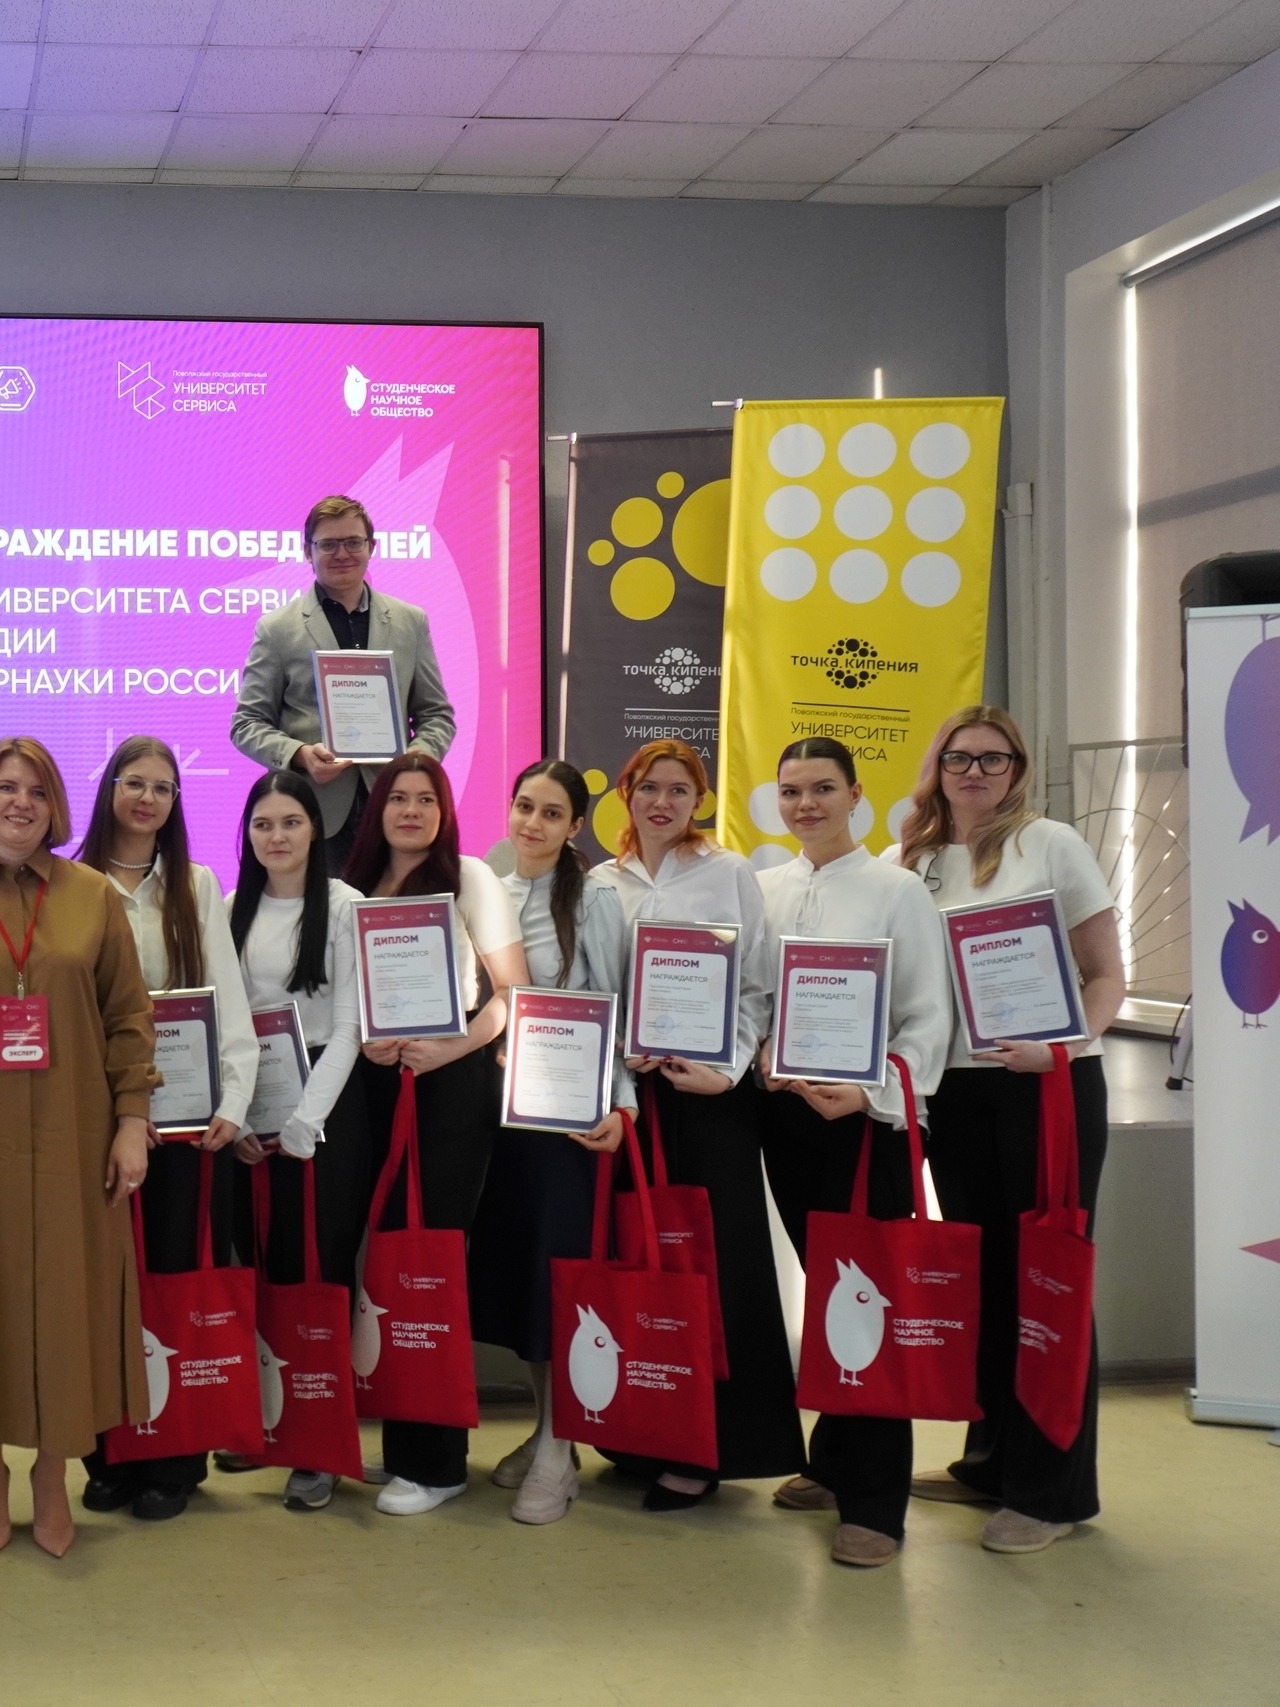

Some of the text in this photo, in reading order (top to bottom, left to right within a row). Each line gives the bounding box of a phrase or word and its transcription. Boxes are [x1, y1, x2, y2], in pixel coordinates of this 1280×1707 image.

[172, 370, 211, 378] Поволжский
[173, 382, 267, 395] УНИВЕРСИТЕТ
[370, 383, 456, 394] СТУДЕНЧЕСКОЕ
[172, 399, 237, 412] СЕРВИСА
[370, 395, 423, 405] НАУЧНОЕ
[370, 407, 434, 418] ОБЩЕСТВО
[187, 525, 431, 563] ПОБЕДЛЕЙ
[199, 587, 303, 614] СЕРВИ
[791, 655, 919, 673] точка кипения
[623, 665, 666, 676] точка
[124, 668, 240, 695] РОССИ
[331, 680, 368, 688] ДИПЛОМ
[624, 713, 666, 721] Поволжский
[791, 707, 910, 722] Поволжский государственный
[624, 726, 720, 741] УНИВЕРСИТЕ
[791, 721, 910, 743] УНИВЕРСИТЕТ
[373, 934, 419, 947] ДИПЛОМ
[969, 937, 1023, 955] ДИПЛОМ
[650, 957, 700, 969] ДИПЛОМ
[796, 975, 848, 986] ДИПЛОМ
[526, 1024, 575, 1037] ДИПЛОМ
[391, 1321, 450, 1332] СТУДЕНЧЕСКОЕ
[893, 1318, 964, 1330] СТУДЕНЧЕСКОЕ
[392, 1330, 428, 1340] НАУЧНОЕ
[894, 1327, 935, 1337] НАУЧНОЕ
[393, 1339, 437, 1349] ОБЩЕСТВО
[894, 1337, 945, 1346] ОБЩЕСТВО
[180, 1355, 242, 1369] СТУДЕНЧЕСКОЕ
[181, 1367, 220, 1378] НАУЧНОЕ
[625, 1361, 693, 1376] СТУДЕНЧЕСКОЕ
[181, 1376, 229, 1387] ОБЩЕСТВО
[626, 1370, 667, 1381] НАУЧНОЕ
[627, 1378, 677, 1391] ОБЩЕСТВО
